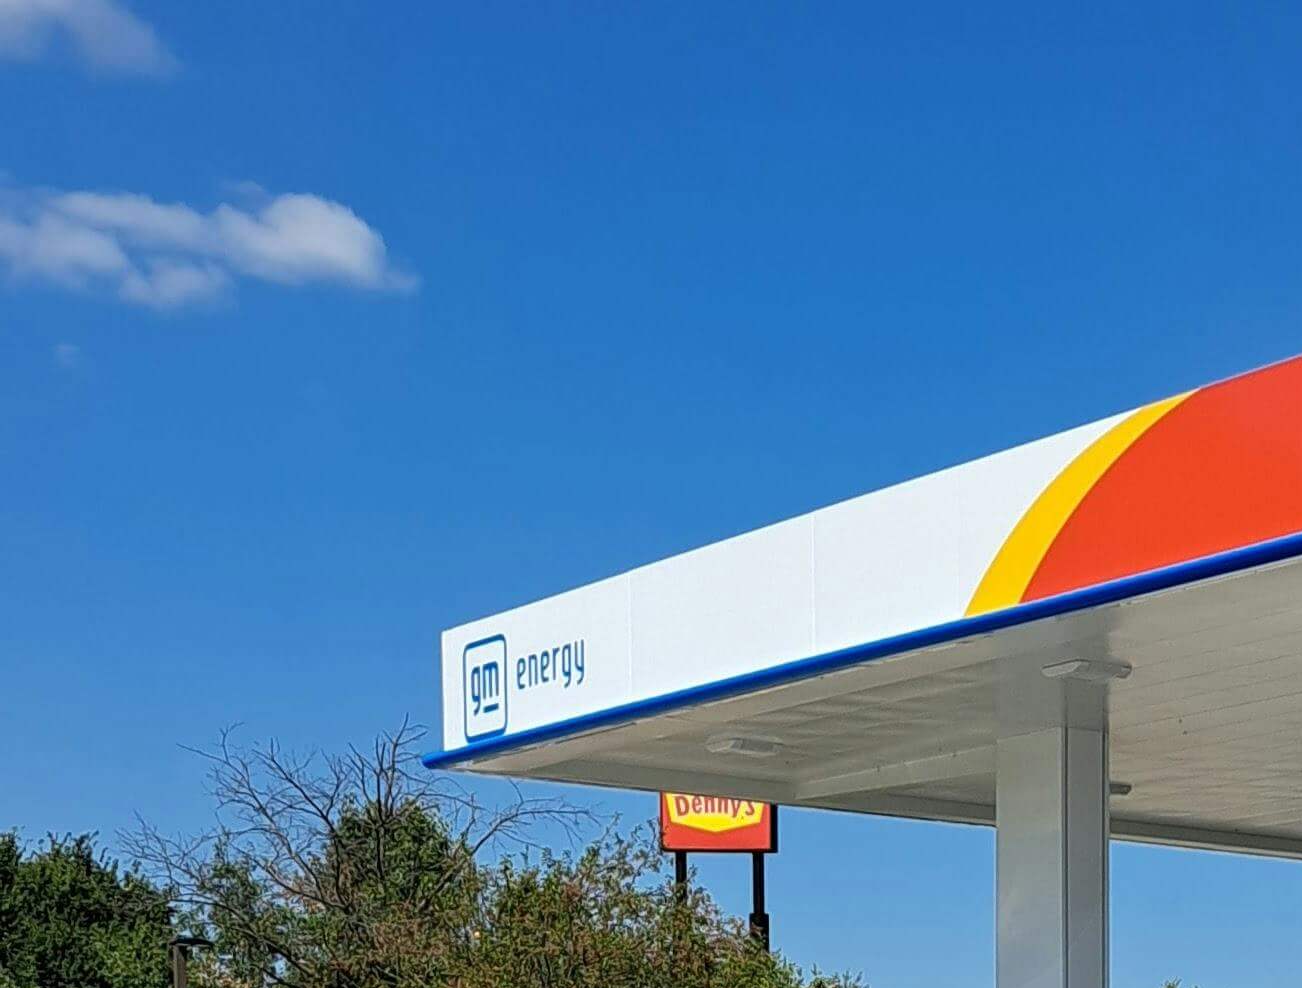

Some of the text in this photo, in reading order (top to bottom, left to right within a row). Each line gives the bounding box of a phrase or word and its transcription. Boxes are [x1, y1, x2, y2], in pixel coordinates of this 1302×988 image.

[470, 638, 586, 717] gm energy
[674, 794, 756, 818] Dennys
